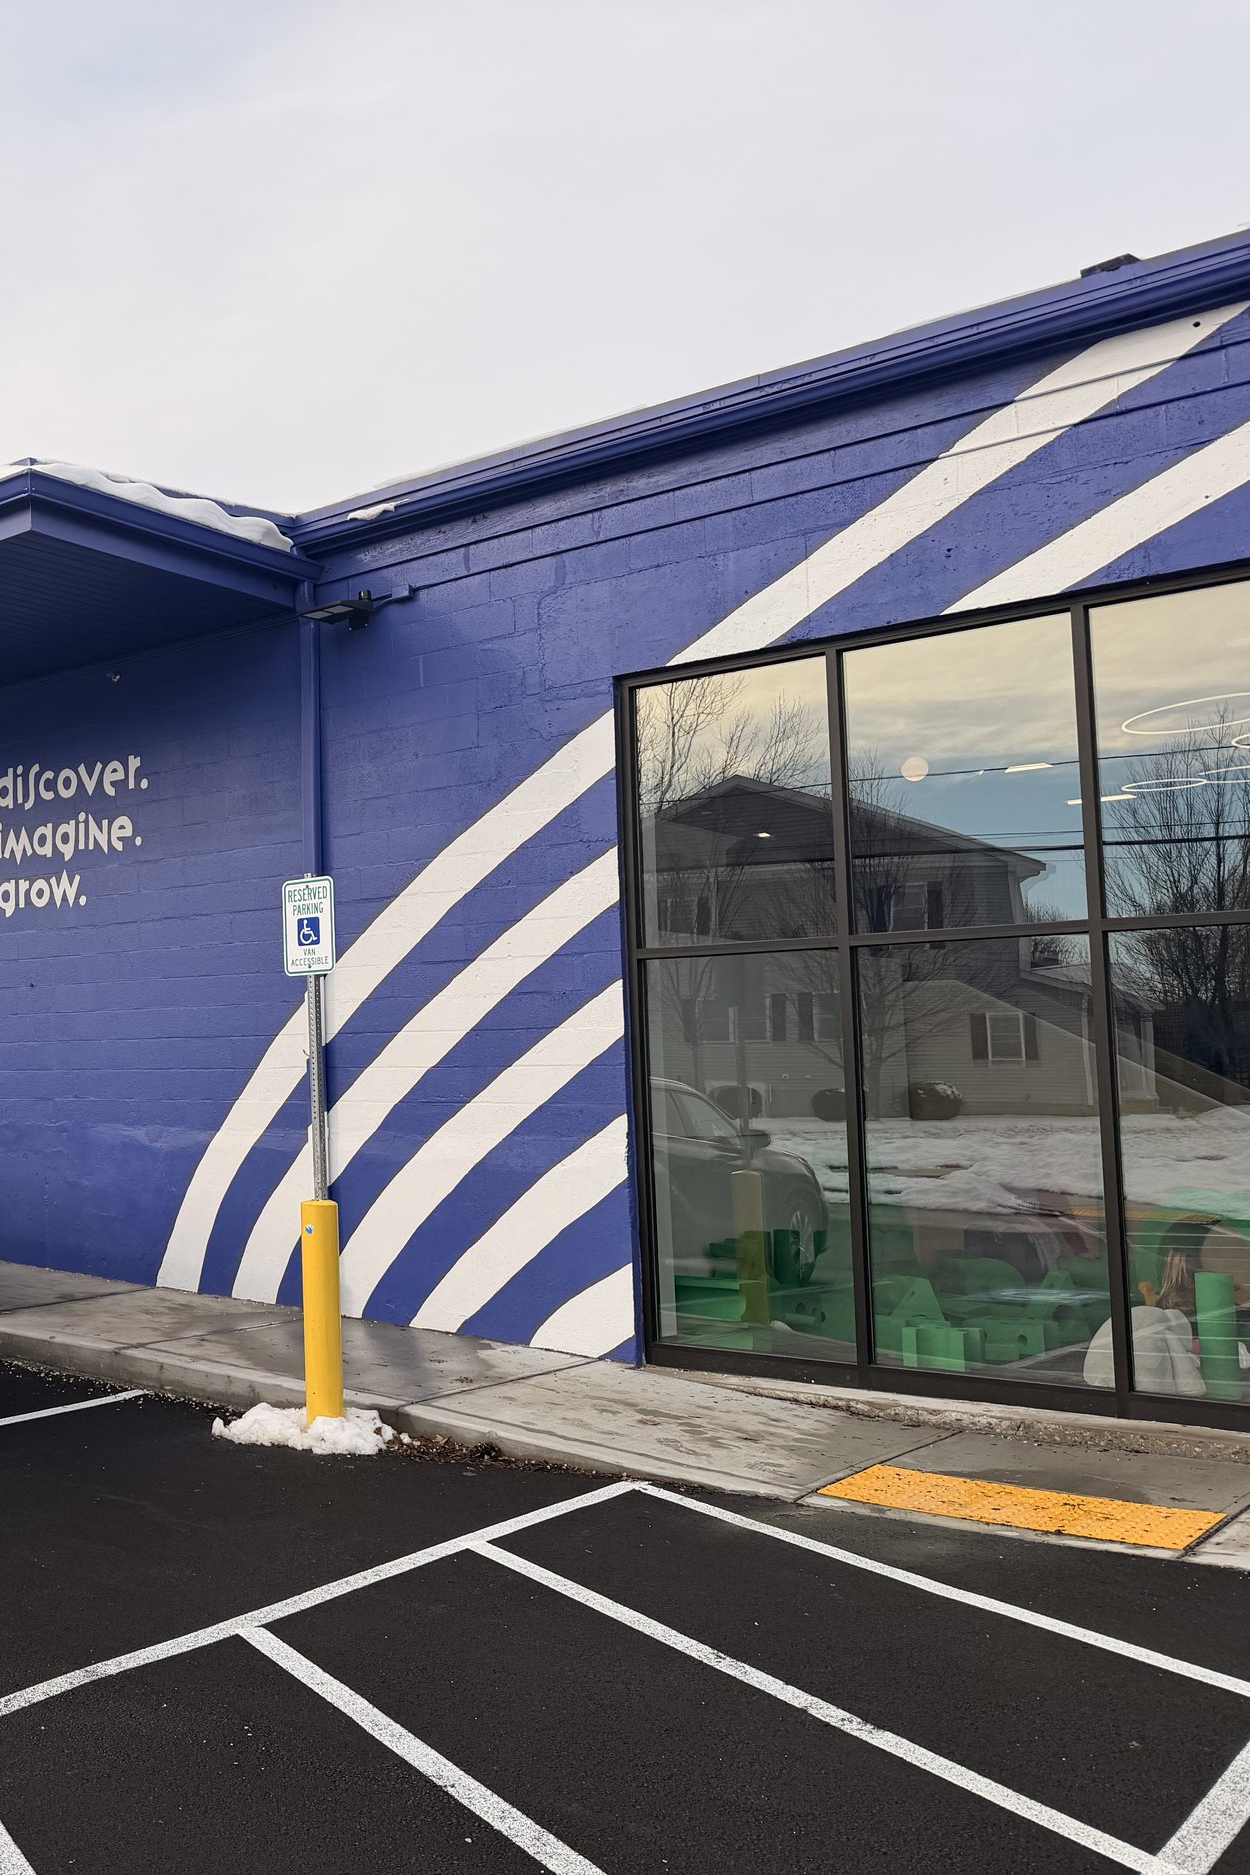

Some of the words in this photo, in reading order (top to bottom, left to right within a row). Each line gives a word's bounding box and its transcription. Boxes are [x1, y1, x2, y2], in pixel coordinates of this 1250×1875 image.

[288, 886, 327, 903] RESERVED
[293, 902, 323, 916] PARKING
[303, 948, 316, 956] VAN
[291, 956, 329, 967] ACCESSIBLE
